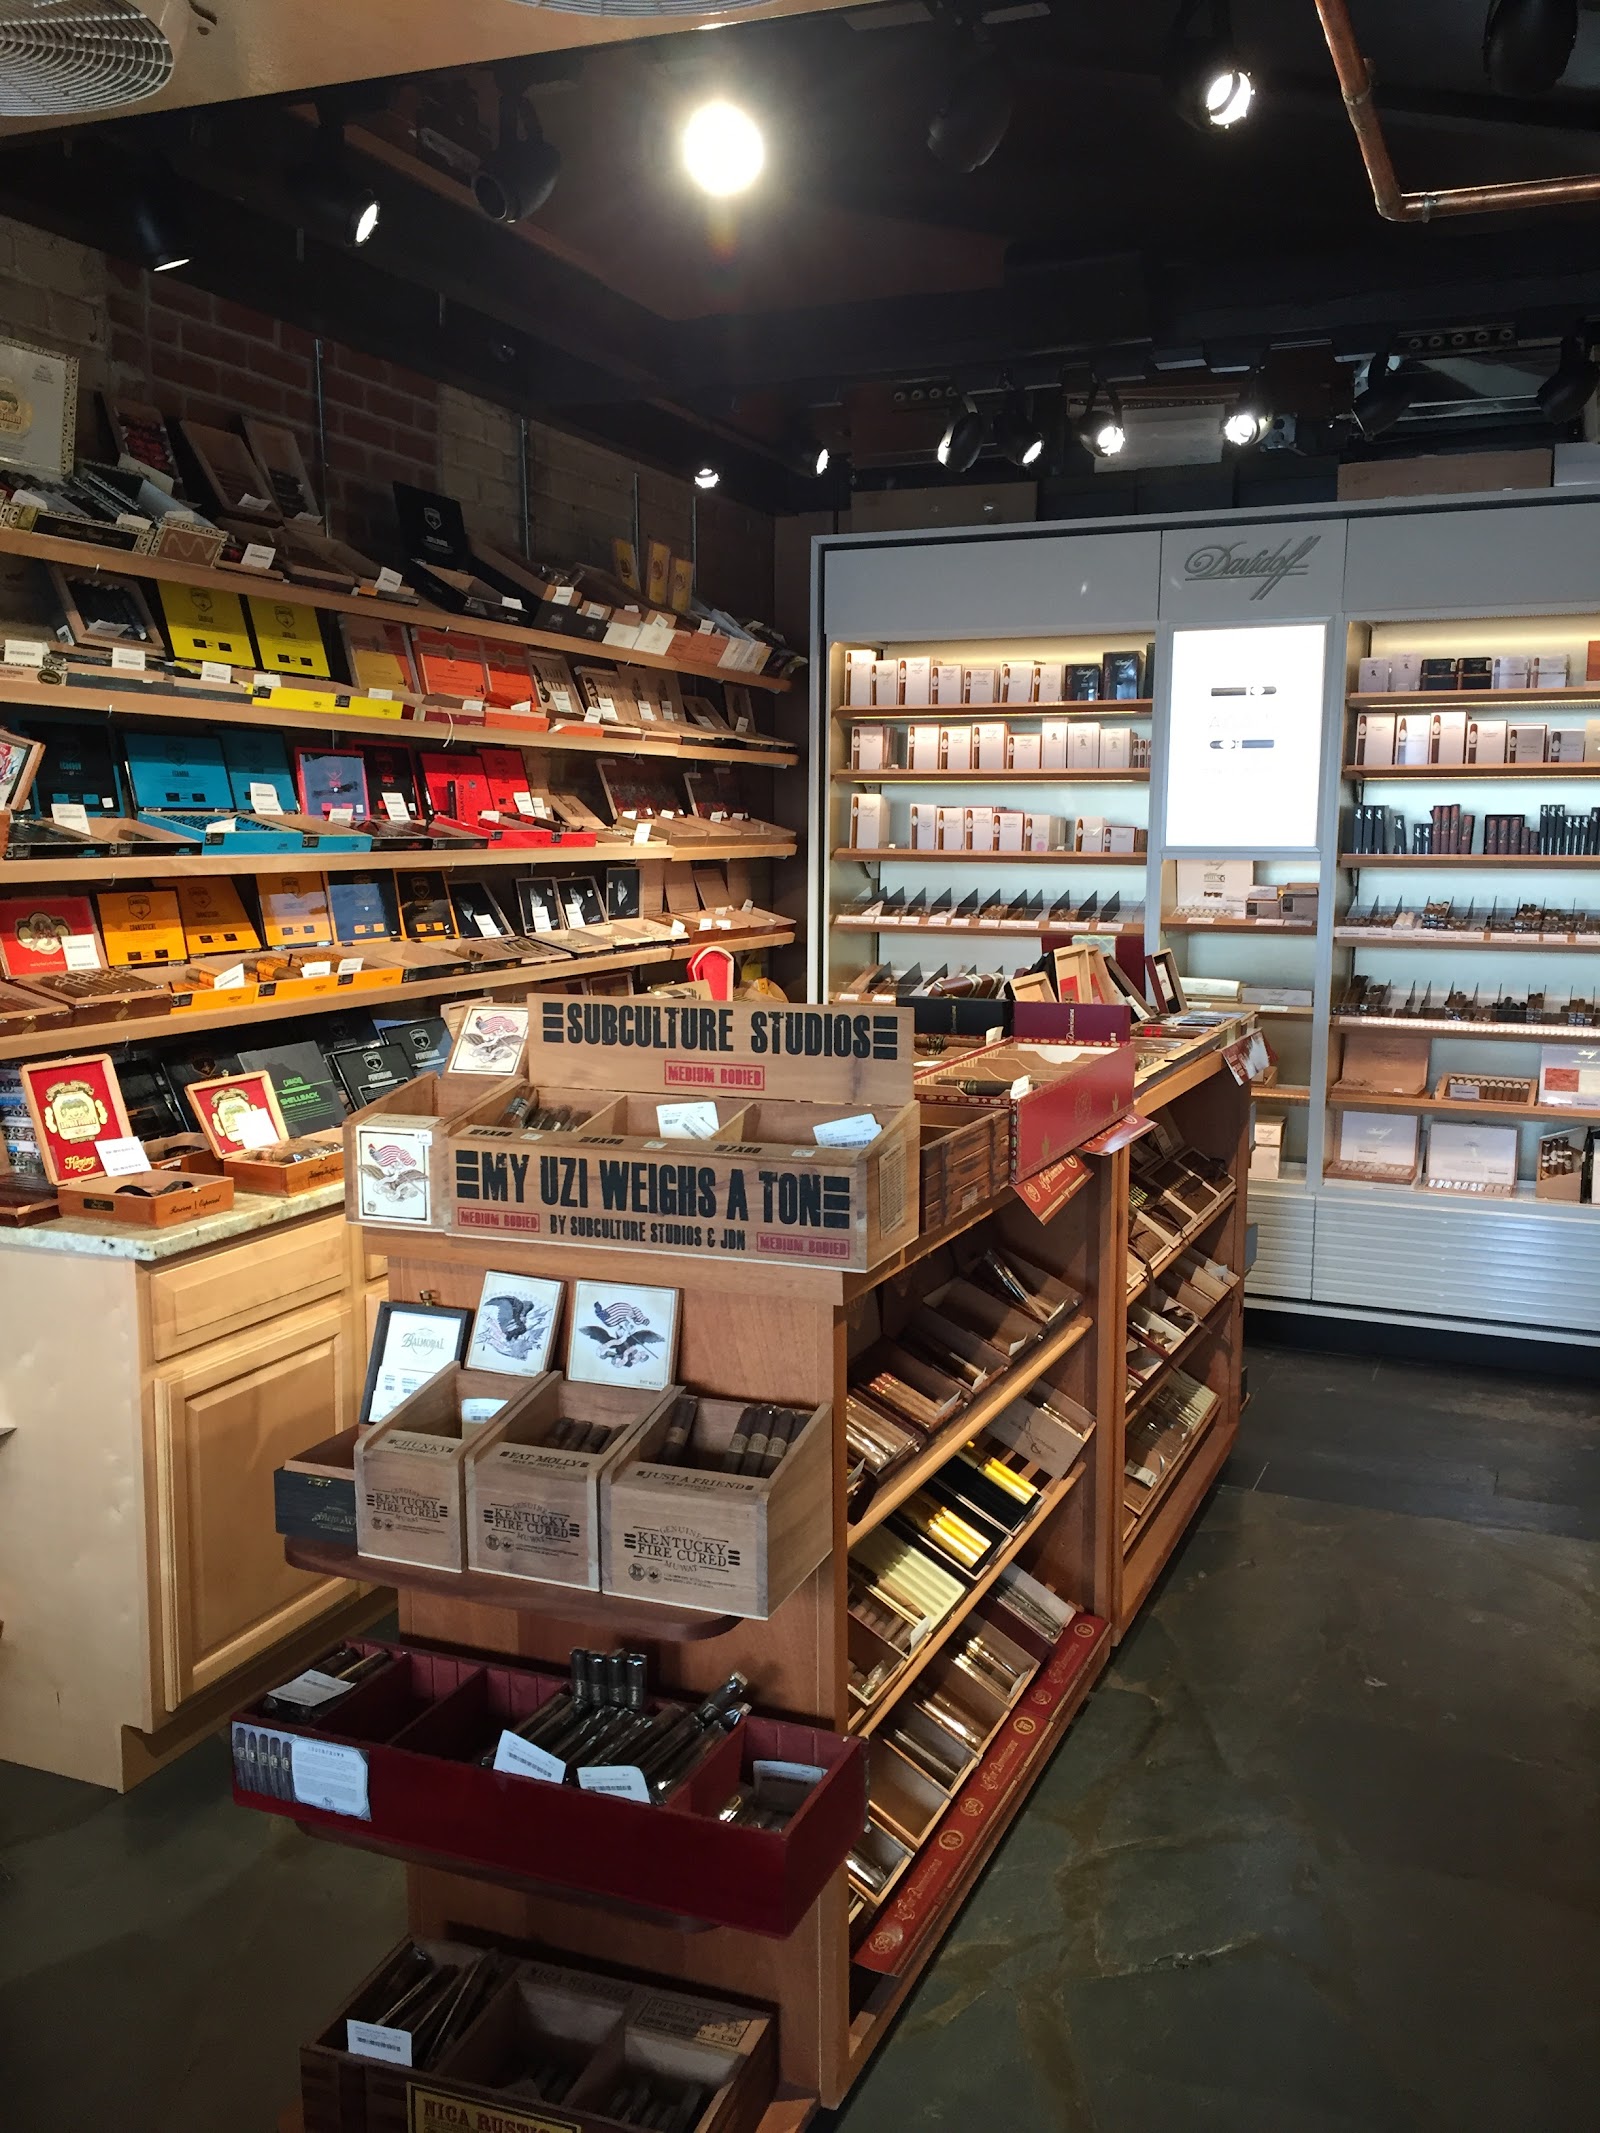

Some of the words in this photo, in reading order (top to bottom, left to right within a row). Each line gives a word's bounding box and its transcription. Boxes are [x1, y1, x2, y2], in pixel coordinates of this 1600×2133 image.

[1184, 535, 1322, 601] Davidoff
[566, 1002, 734, 1052] SUBCULTURE
[750, 1010, 871, 1059] STUDIOS
[668, 1065, 715, 1083] MEDIUM
[720, 1067, 762, 1087] BODIED
[280, 1091, 320, 1105] SHELLBACK
[481, 1151, 530, 1204] MY
[540, 1155, 588, 1208] UZI
[599, 1160, 717, 1219] WEIGHS
[726, 1168, 749, 1221] A
[759, 1170, 821, 1228] TON
[460, 1210, 500, 1225] MEDIUM
[503, 1215, 538, 1229] BODIED
[549, 1214, 566, 1235] BY
[570, 1216, 646, 1241] SUBCULTURE
[651, 1222, 701, 1246] STUDIOS
[706, 1227, 716, 1247] &
[720, 1228, 746, 1250] JDN
[759, 1236, 804, 1252] MEDIUM
[808, 1242, 847, 1256] BODIED
[401, 1332, 444, 1350] BALMORAL
[394, 1439, 448, 1452] CHUNKY
[508, 1451, 535, 1461] FAT
[536, 1455, 581, 1467] MOLLY
[641, 1470, 680, 1481] JUST
[690, 1478, 745, 1491] FRIEND
[376, 1492, 438, 1510] KENTUCKY
[376, 1501, 401, 1513] FIRE
[403, 1506, 439, 1519] CURED
[512, 1502, 549, 1514] GENUINE
[494, 1508, 568, 1528] KENTUCKY
[495, 1517, 524, 1532] FIRE
[526, 1523, 569, 1539] CURED
[516, 1532, 545, 1543] MUWAT
[659, 1525, 703, 1539] GENUINE
[637, 1531, 726, 1555] KENTUCKY
[637, 1542, 673, 1559] FIRE
[676, 1549, 727, 1567] CURED
[664, 1560, 698, 1572] MUWAT
[990, 1740, 1018, 1773] Dominicana
[424, 2100, 470, 2125] NICA
[476, 2111, 550, 2133] RUST
